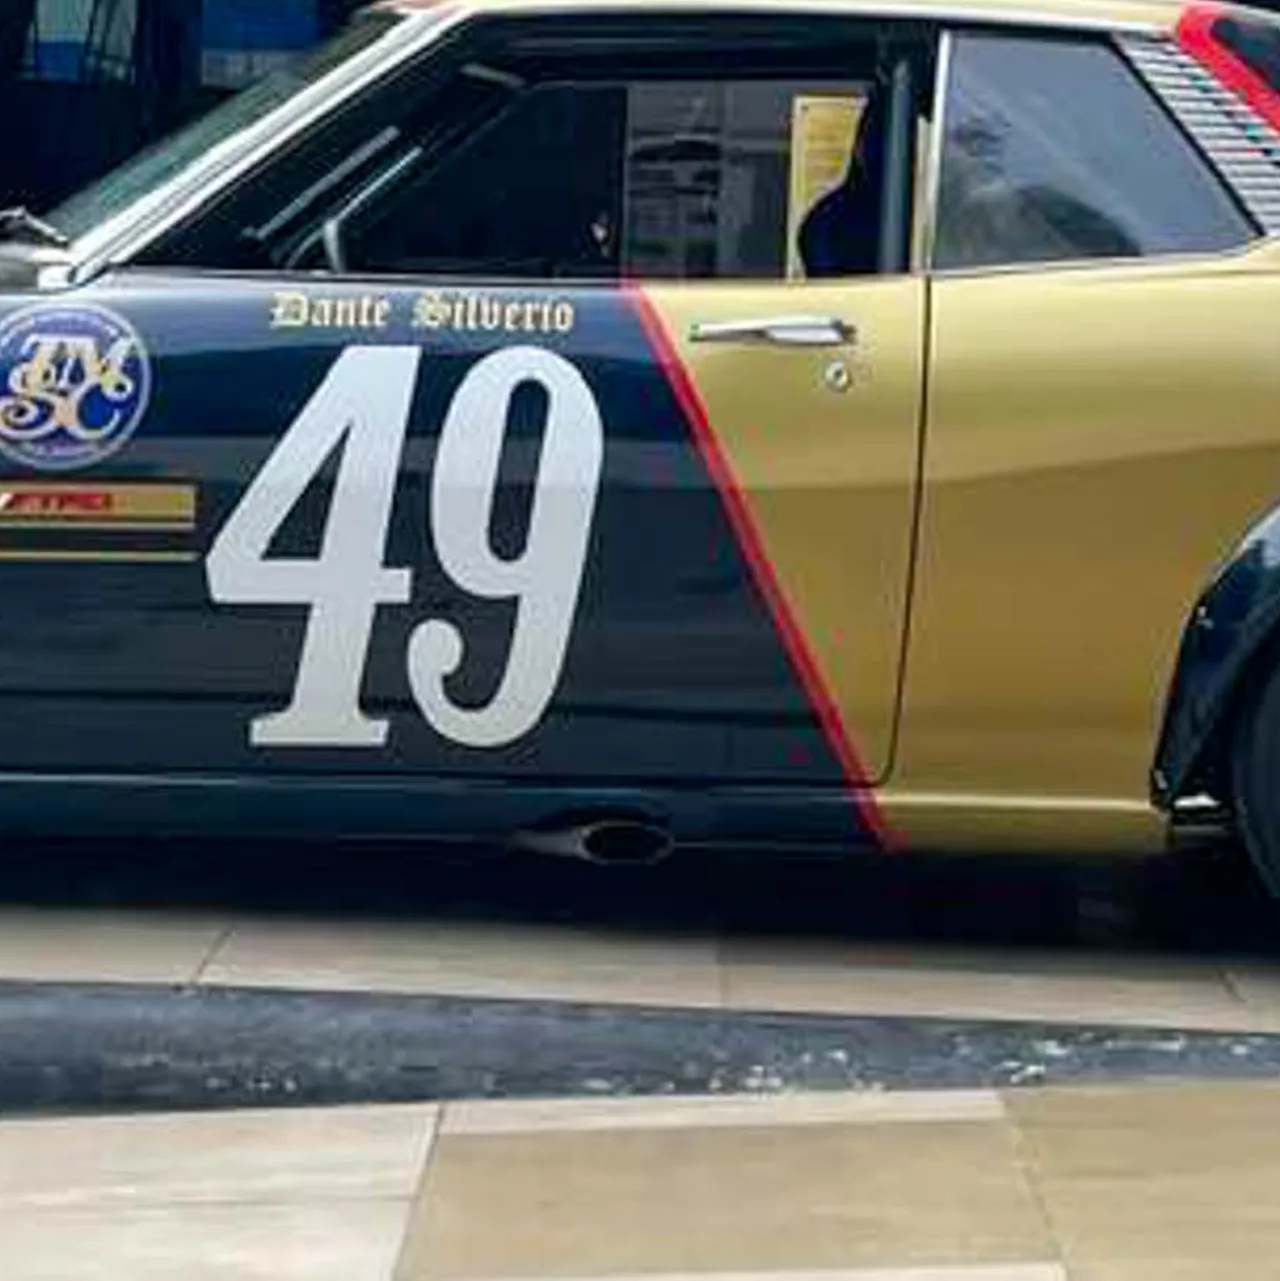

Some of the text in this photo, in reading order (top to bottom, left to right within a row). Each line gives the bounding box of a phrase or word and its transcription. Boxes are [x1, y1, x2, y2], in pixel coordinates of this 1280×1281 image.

[271, 291, 574, 331] Dante Silverio
[205, 344, 605, 748] 49
